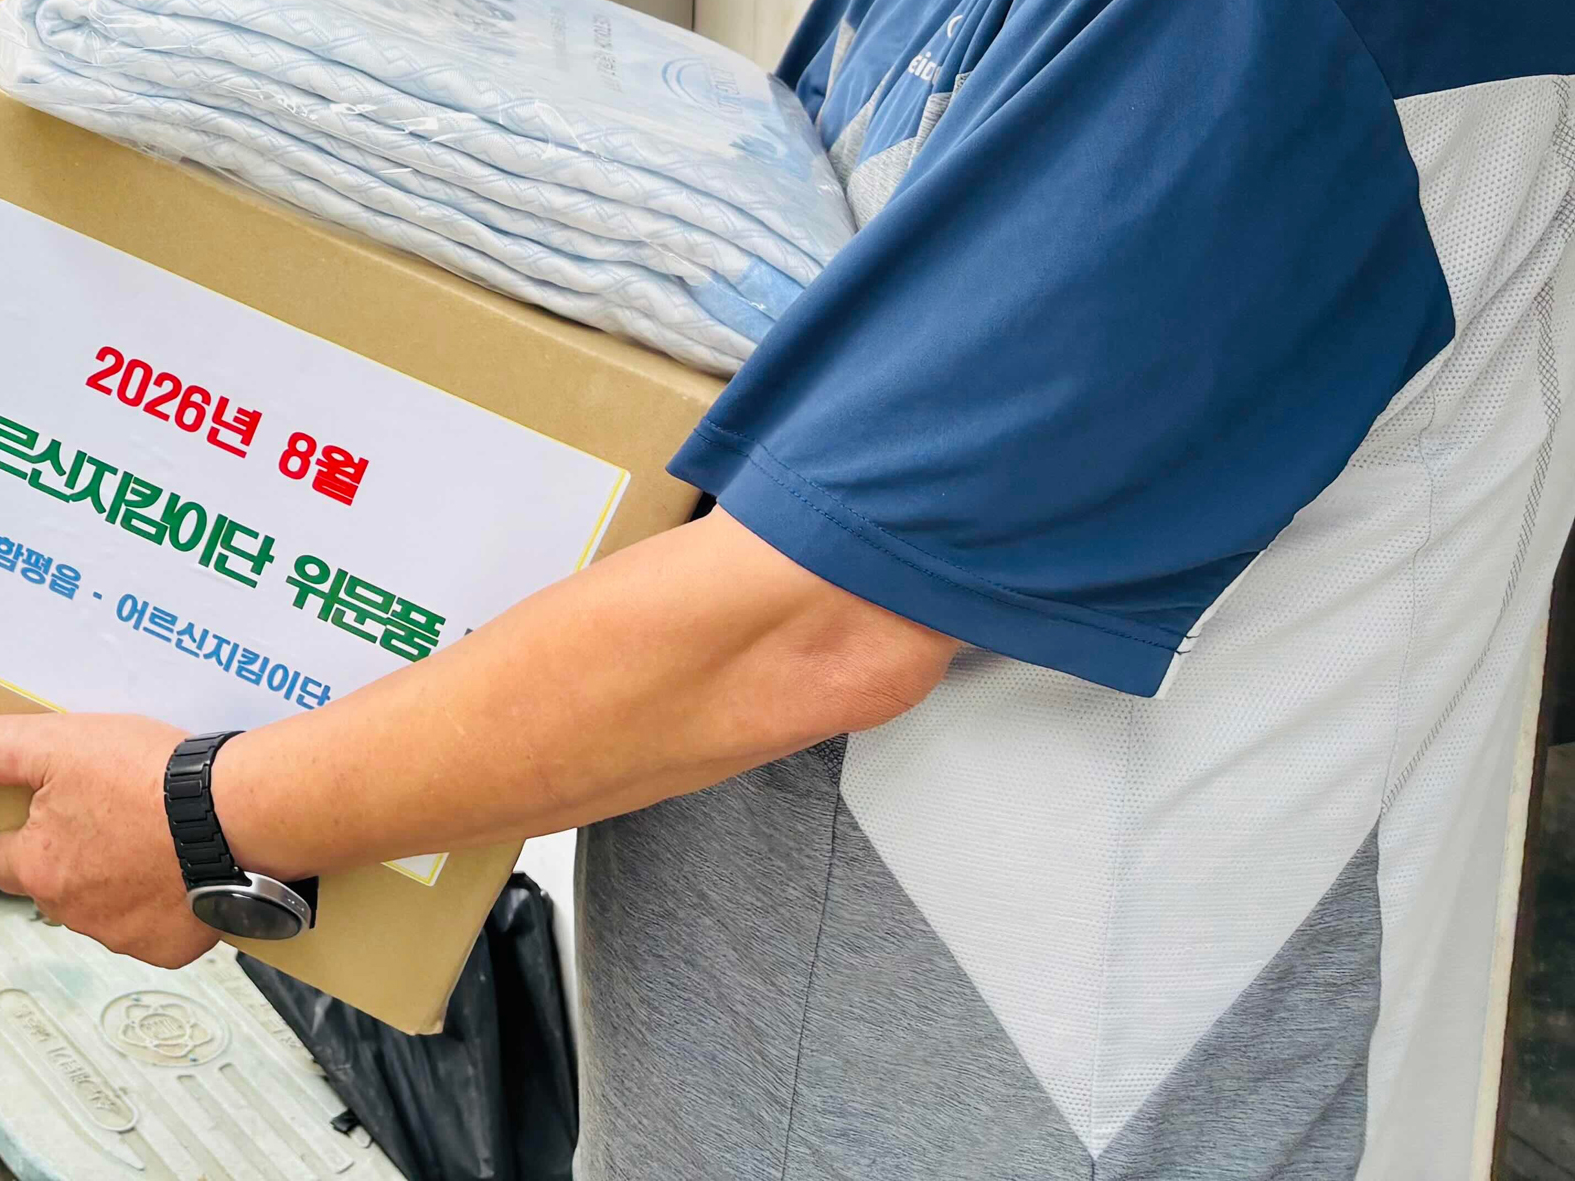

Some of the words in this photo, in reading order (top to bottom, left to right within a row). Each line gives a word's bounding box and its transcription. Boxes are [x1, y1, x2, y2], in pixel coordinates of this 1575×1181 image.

[85, 346, 263, 459] 2026년
[278, 432, 369, 506] 8월
[116, 593, 331, 710] 어르신지킴이단
[286, 555, 446, 663] 위문품
